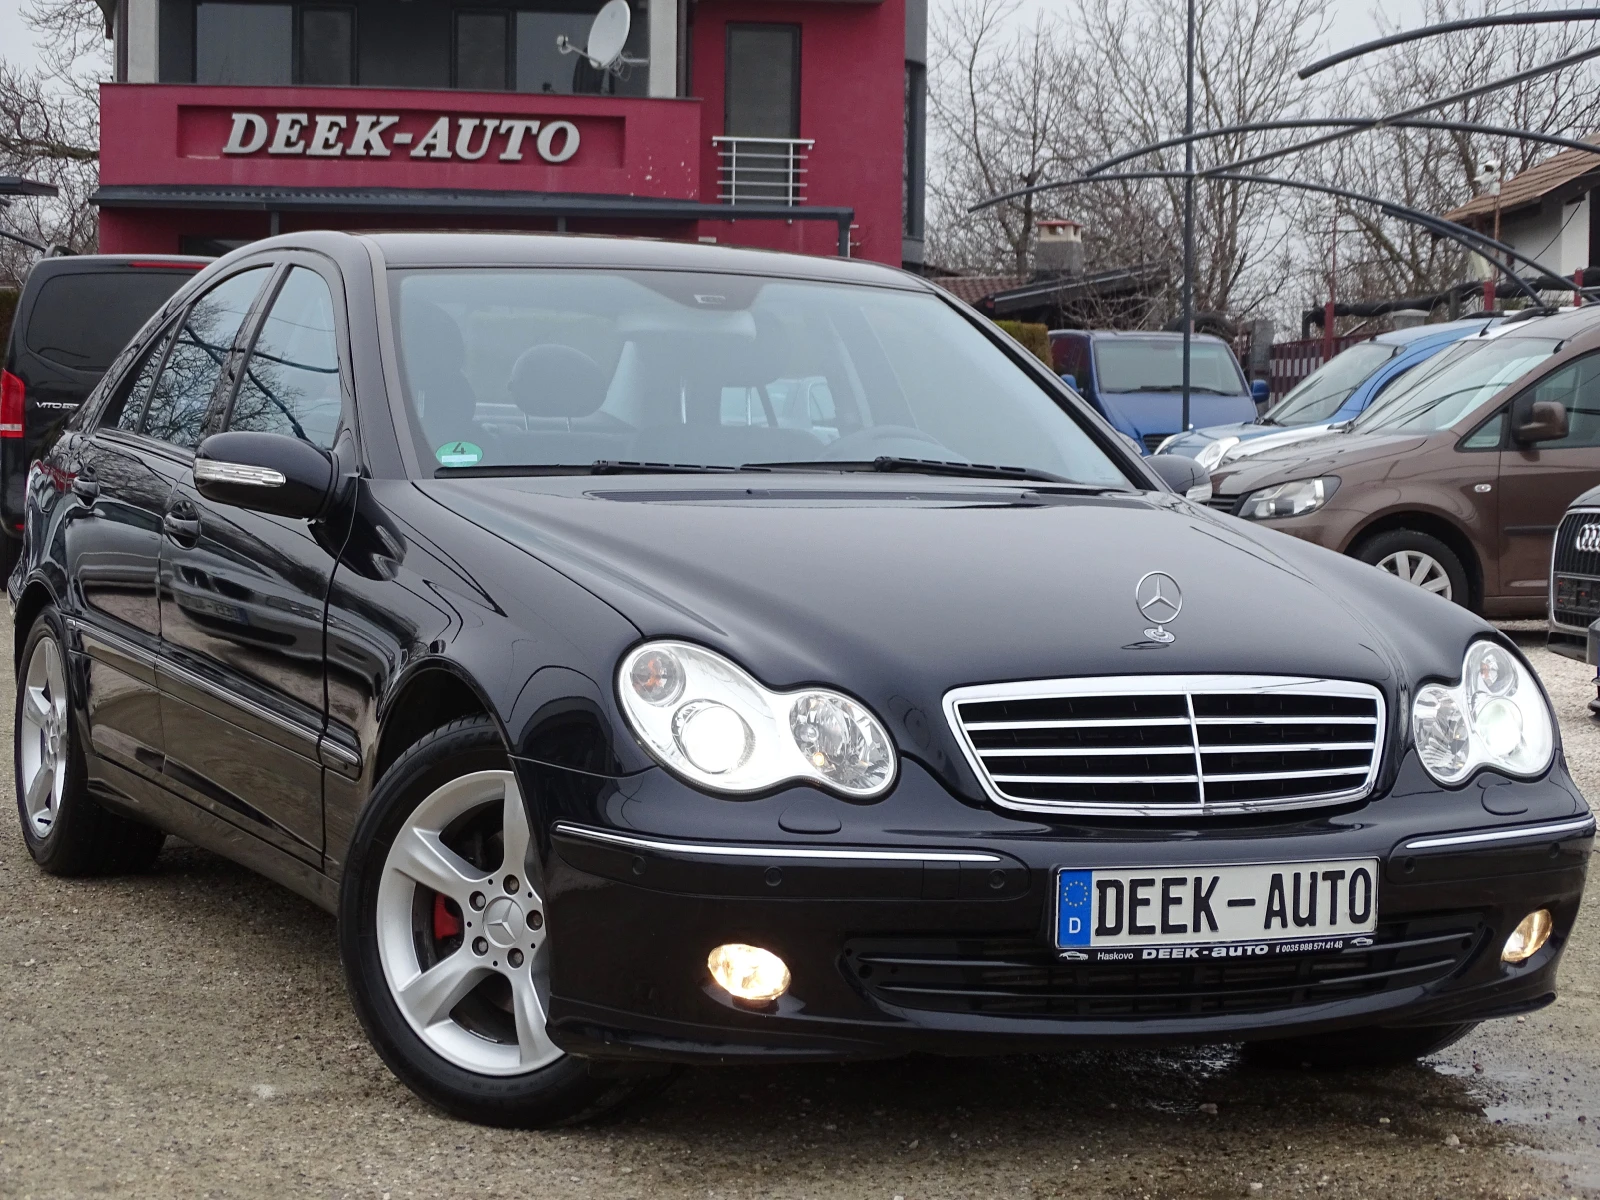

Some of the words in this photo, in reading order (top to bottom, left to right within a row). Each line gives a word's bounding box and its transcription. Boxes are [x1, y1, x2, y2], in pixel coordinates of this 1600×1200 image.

[222, 112, 581, 163] DEEK-AUTO
[36, 401, 62, 409] VITO
[452, 442, 467, 455] 4
[1069, 917, 1082, 934] D
[1097, 951, 1134, 960] Haskovo
[1281, 944, 1299, 953] 0035
[1300, 942, 1313, 951] 988
